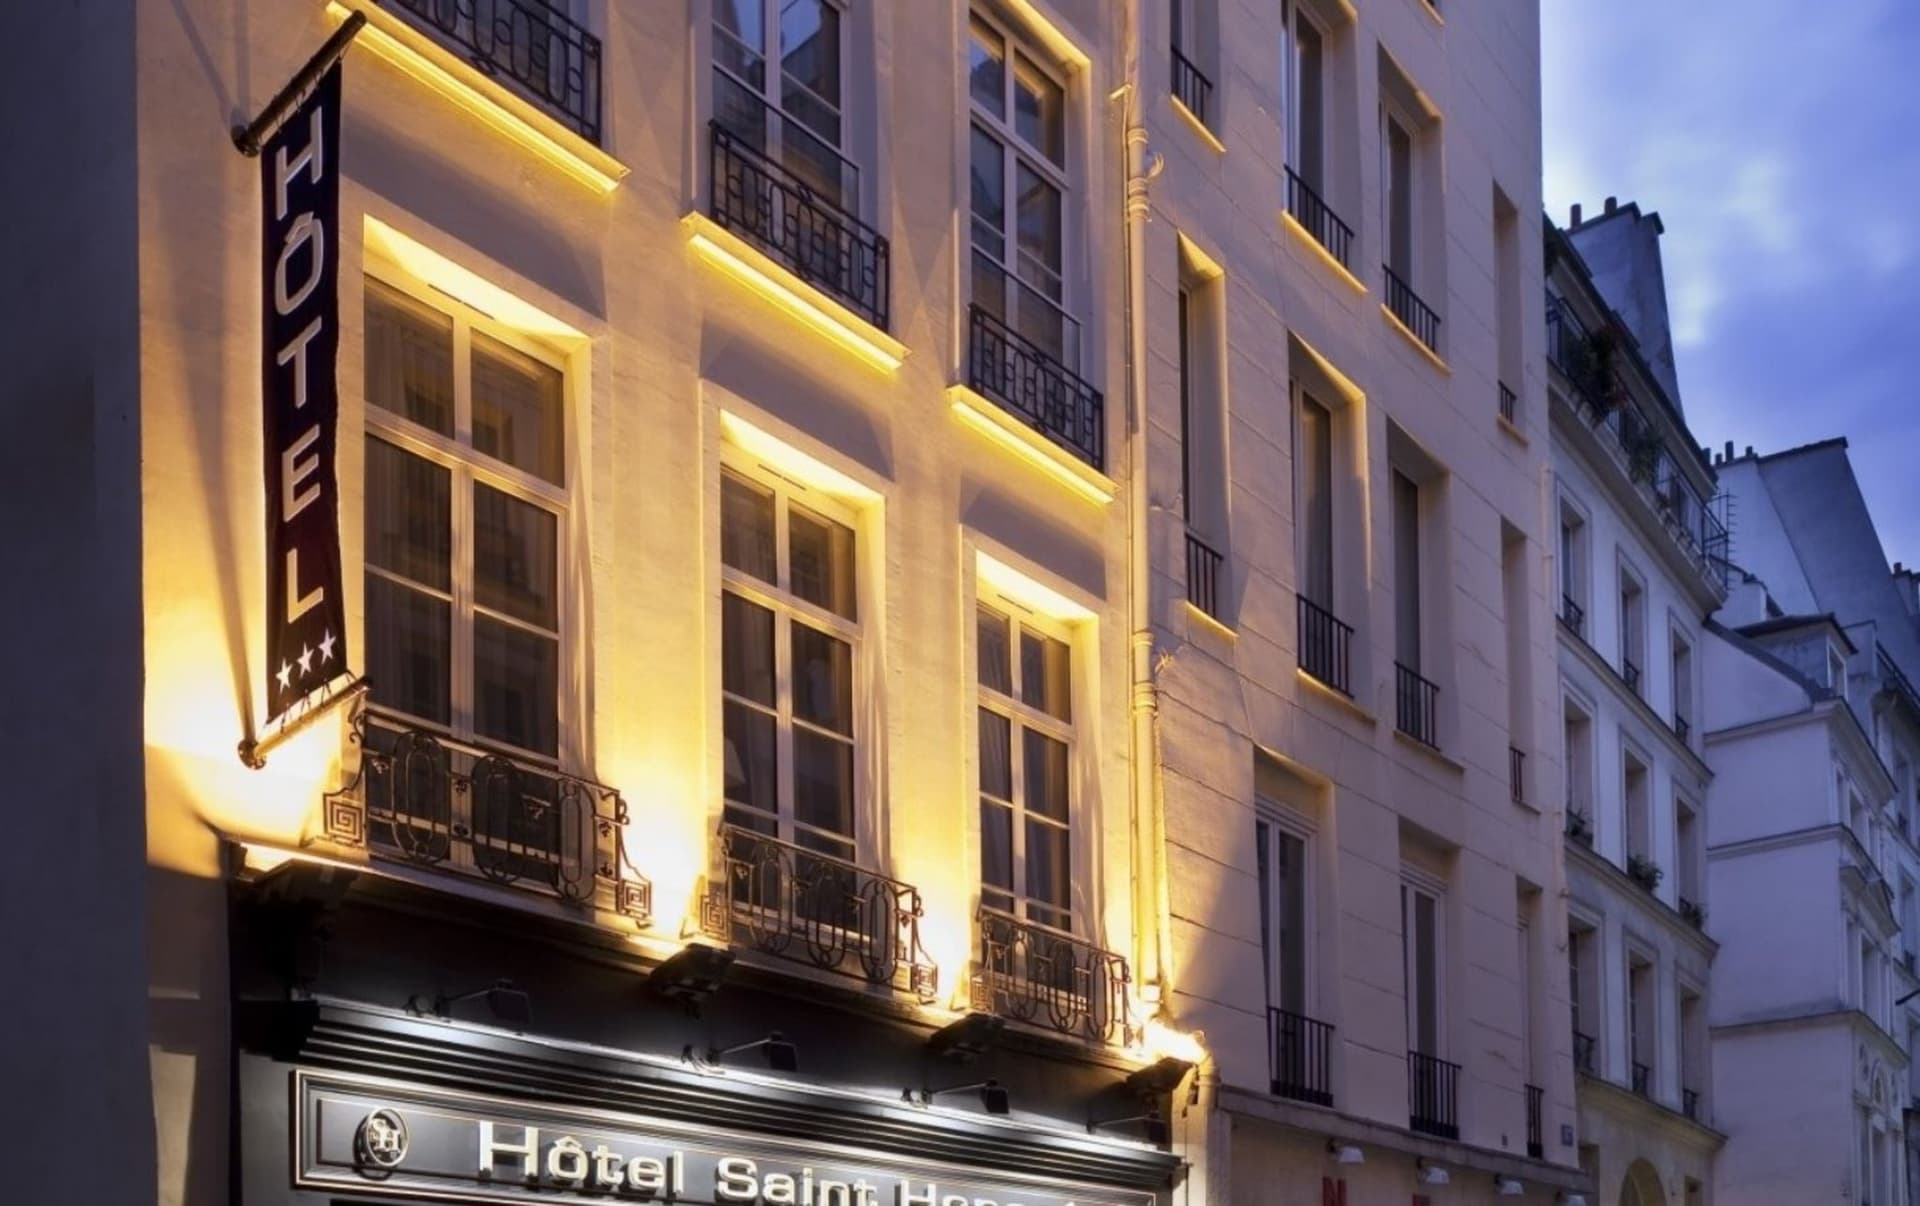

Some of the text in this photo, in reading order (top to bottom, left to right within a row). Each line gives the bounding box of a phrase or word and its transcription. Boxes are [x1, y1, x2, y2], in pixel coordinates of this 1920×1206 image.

[274, 106, 324, 624] HÔTEL
[479, 1120, 684, 1194] Hôtel
[718, 1157, 879, 1206] Saint
